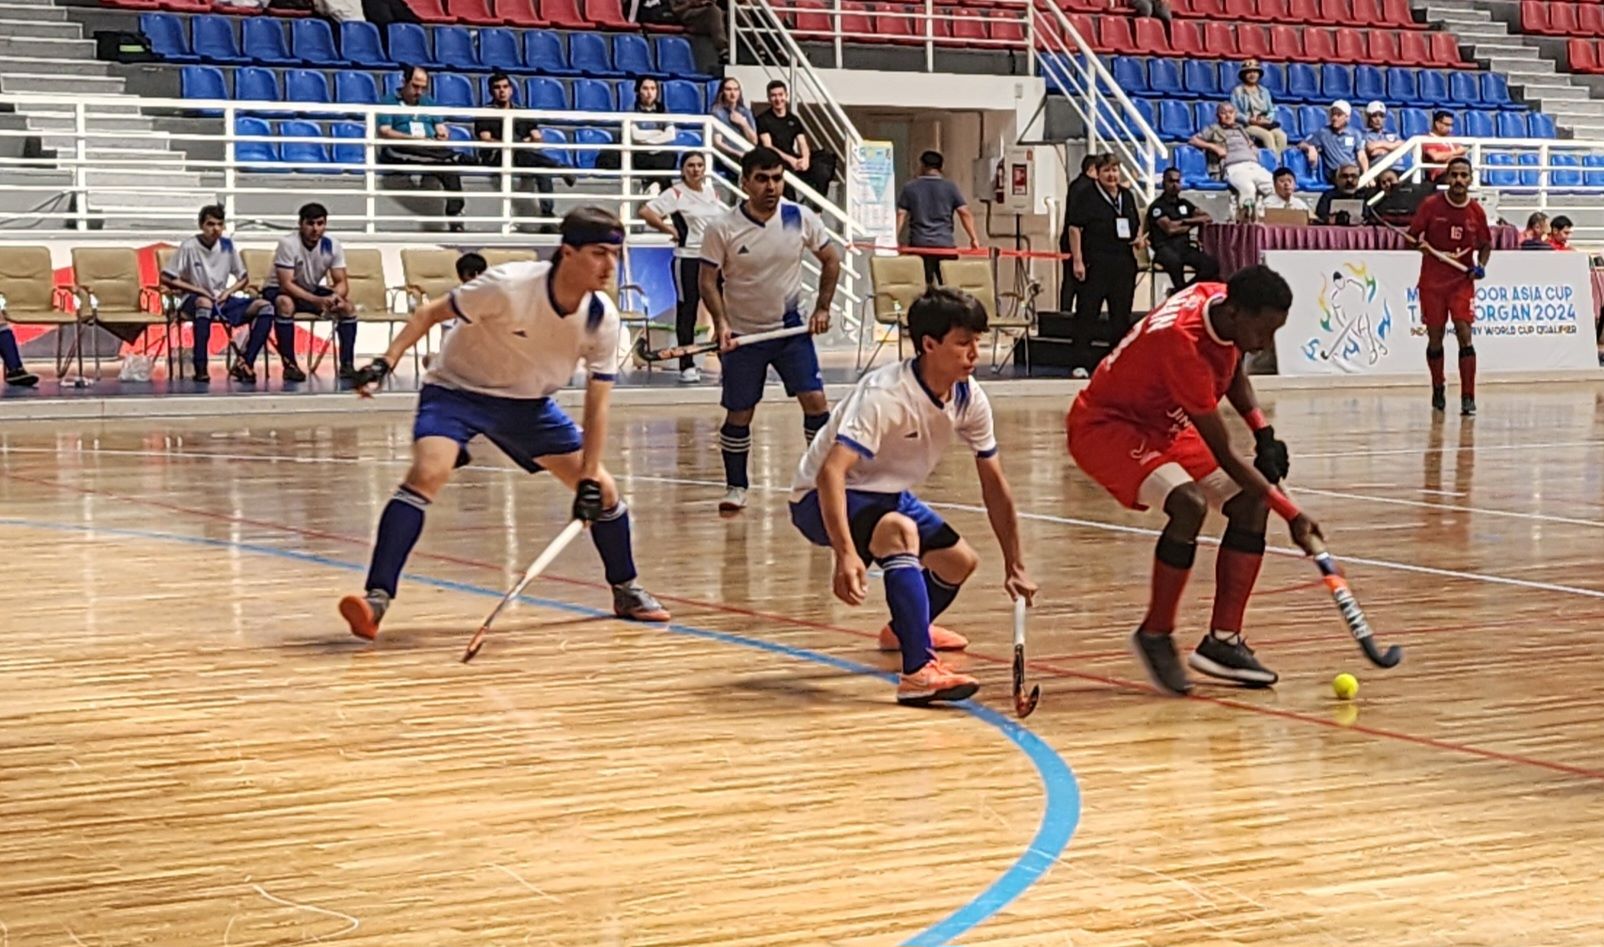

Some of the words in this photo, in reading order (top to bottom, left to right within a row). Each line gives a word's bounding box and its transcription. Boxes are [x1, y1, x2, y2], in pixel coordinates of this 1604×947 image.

[1475, 286, 1507, 301] OOR
[1512, 286, 1542, 301] ASIA
[1545, 286, 1572, 301] CUP
[1534, 304, 1576, 321] 2024
[1484, 325, 1516, 335] WORLD
[1518, 325, 1534, 335] CUP
[1166, 407, 1192, 427] JIN
